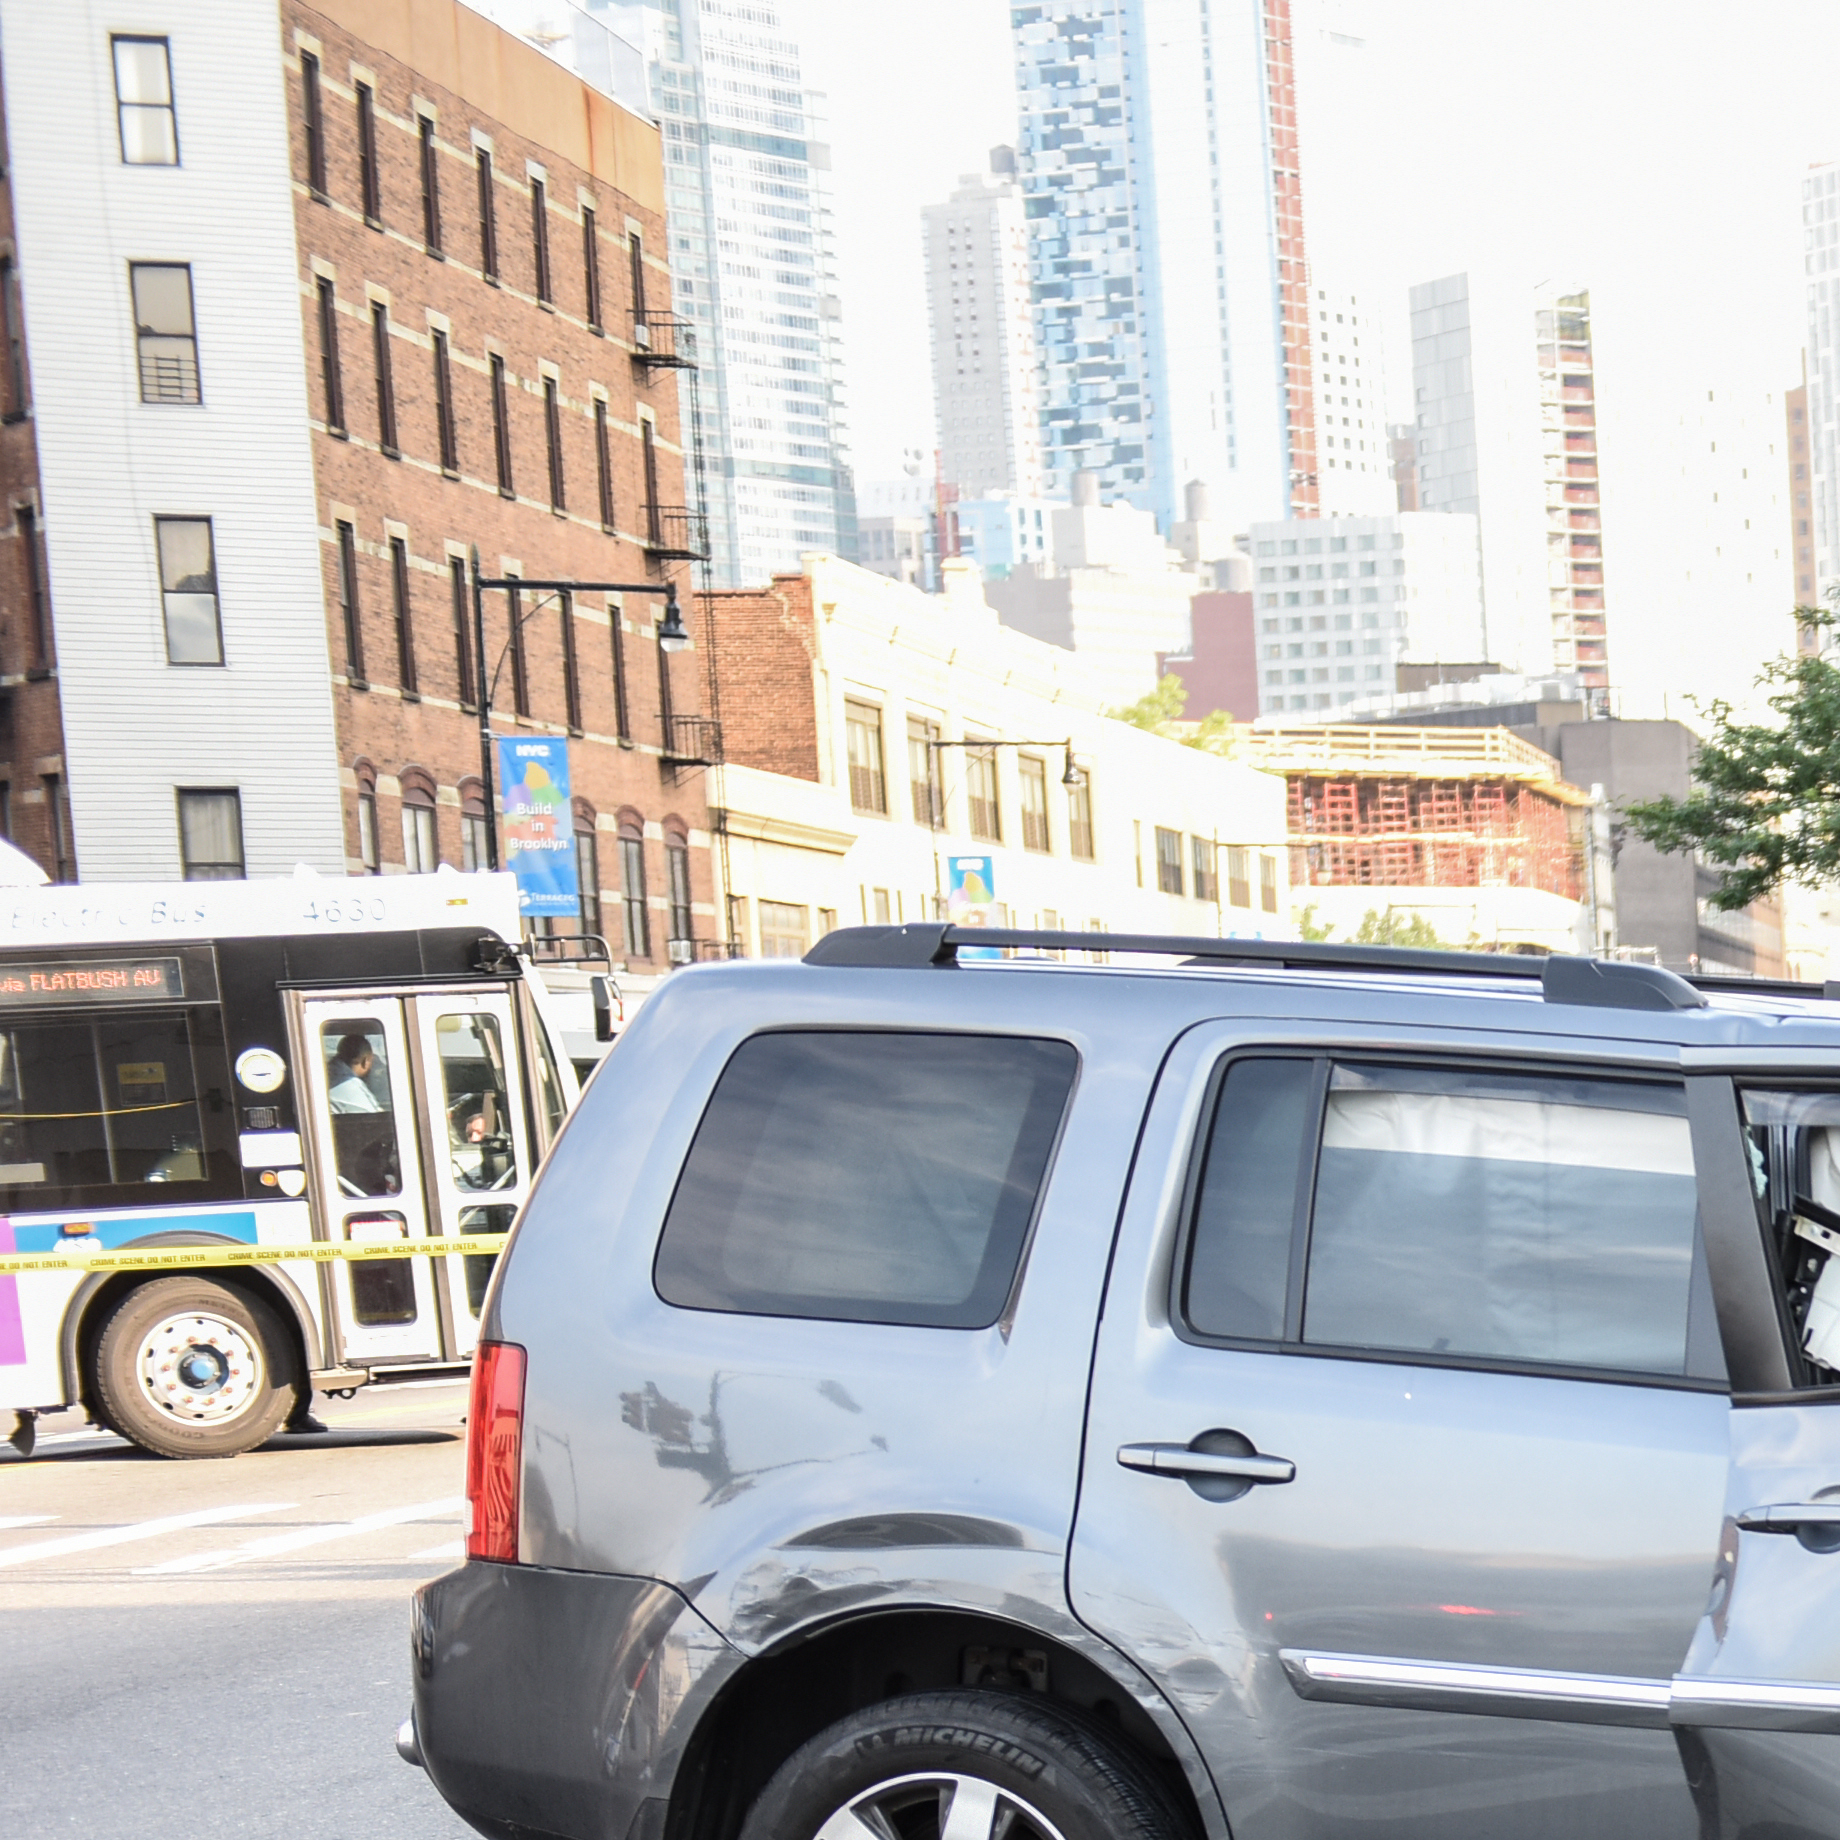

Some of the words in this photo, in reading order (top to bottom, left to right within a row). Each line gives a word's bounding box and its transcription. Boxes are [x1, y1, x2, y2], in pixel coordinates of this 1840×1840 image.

[516, 803, 553, 815] Build
[531, 820, 545, 832] in
[510, 838, 567, 851] Brooklyn
[150, 901, 207, 925] Bus
[30, 969, 128, 992] FLATBUSH
[134, 969, 161, 987] AV
[228, 1252, 253, 1261] CRIME
[256, 1251, 282, 1260] SCENE
[284, 1250, 295, 1259] DO
[297, 1250, 314, 1258] NOT
[317, 1248, 342, 1257] ENTER
[364, 1247, 389, 1255] CRIME
[392, 1245, 417, 1254] SCENE
[420, 1244, 431, 1252] DO
[433, 1243, 449, 1252] NOT
[452, 1242, 478, 1251] ENTER
[9, 1262, 20, 1270] DO
[22, 1261, 39, 1269] NOT
[42, 1259, 68, 1269] ENTER
[90, 1257, 117, 1267] CRIME
[119, 1256, 145, 1265] SCENE
[147, 1256, 158, 1264] DO
[161, 1255, 178, 1264] NOT
[180, 1254, 206, 1263] ENTER
[894, 1727, 1046, 1777] MICHELIN
